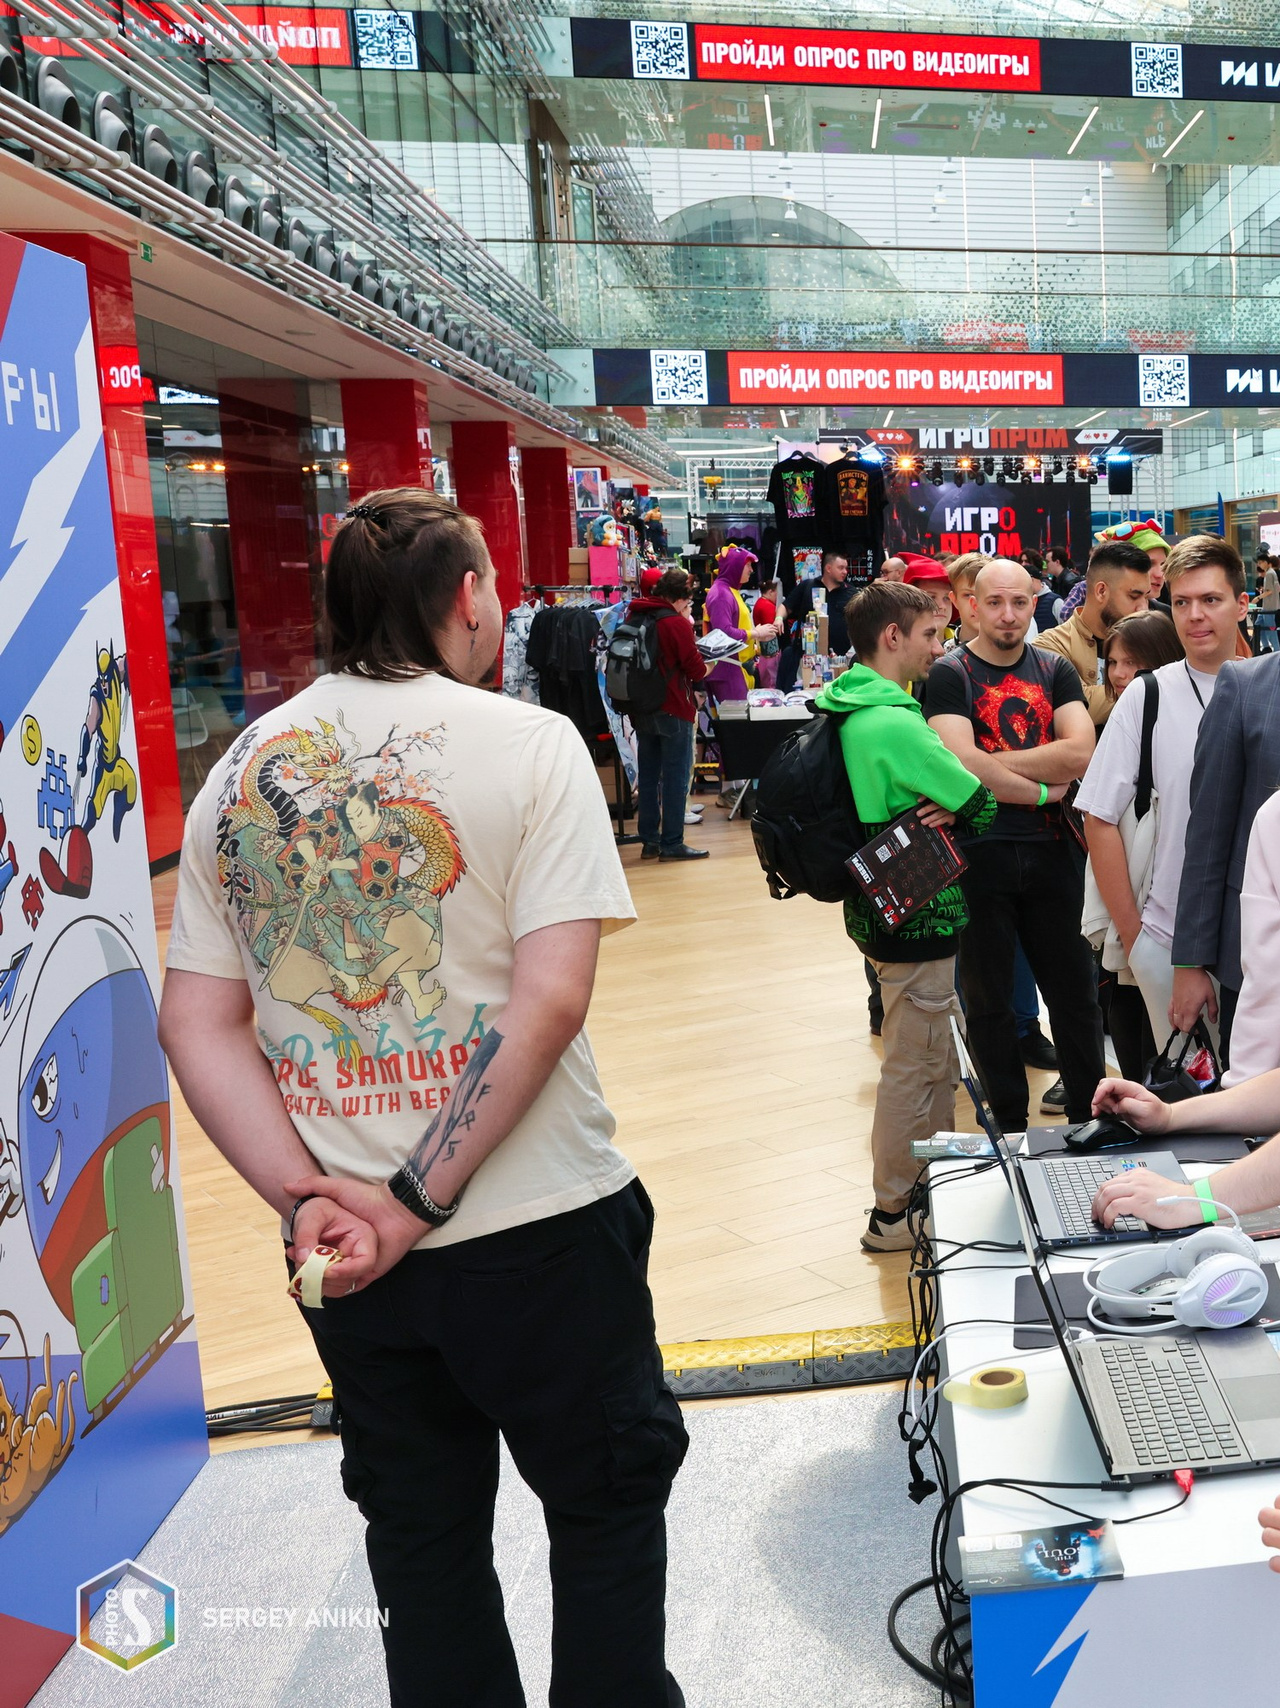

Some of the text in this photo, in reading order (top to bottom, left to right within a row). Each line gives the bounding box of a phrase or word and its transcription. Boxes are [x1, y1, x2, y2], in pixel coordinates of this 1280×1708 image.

[701, 38, 1030, 76] ПРОЙДИ ОПРОС ПРО ВИДЕОИГРЫ
[739, 364, 1053, 393] ПРОЙДИ ОПРОС ПРО ВИДЕОИГРЫ
[918, 427, 1069, 449] ИГРОПРОМ
[944, 506, 1017, 532] ИГРО
[940, 532, 1023, 558] ПРОМ
[342, 1091, 401, 1118] WITH
